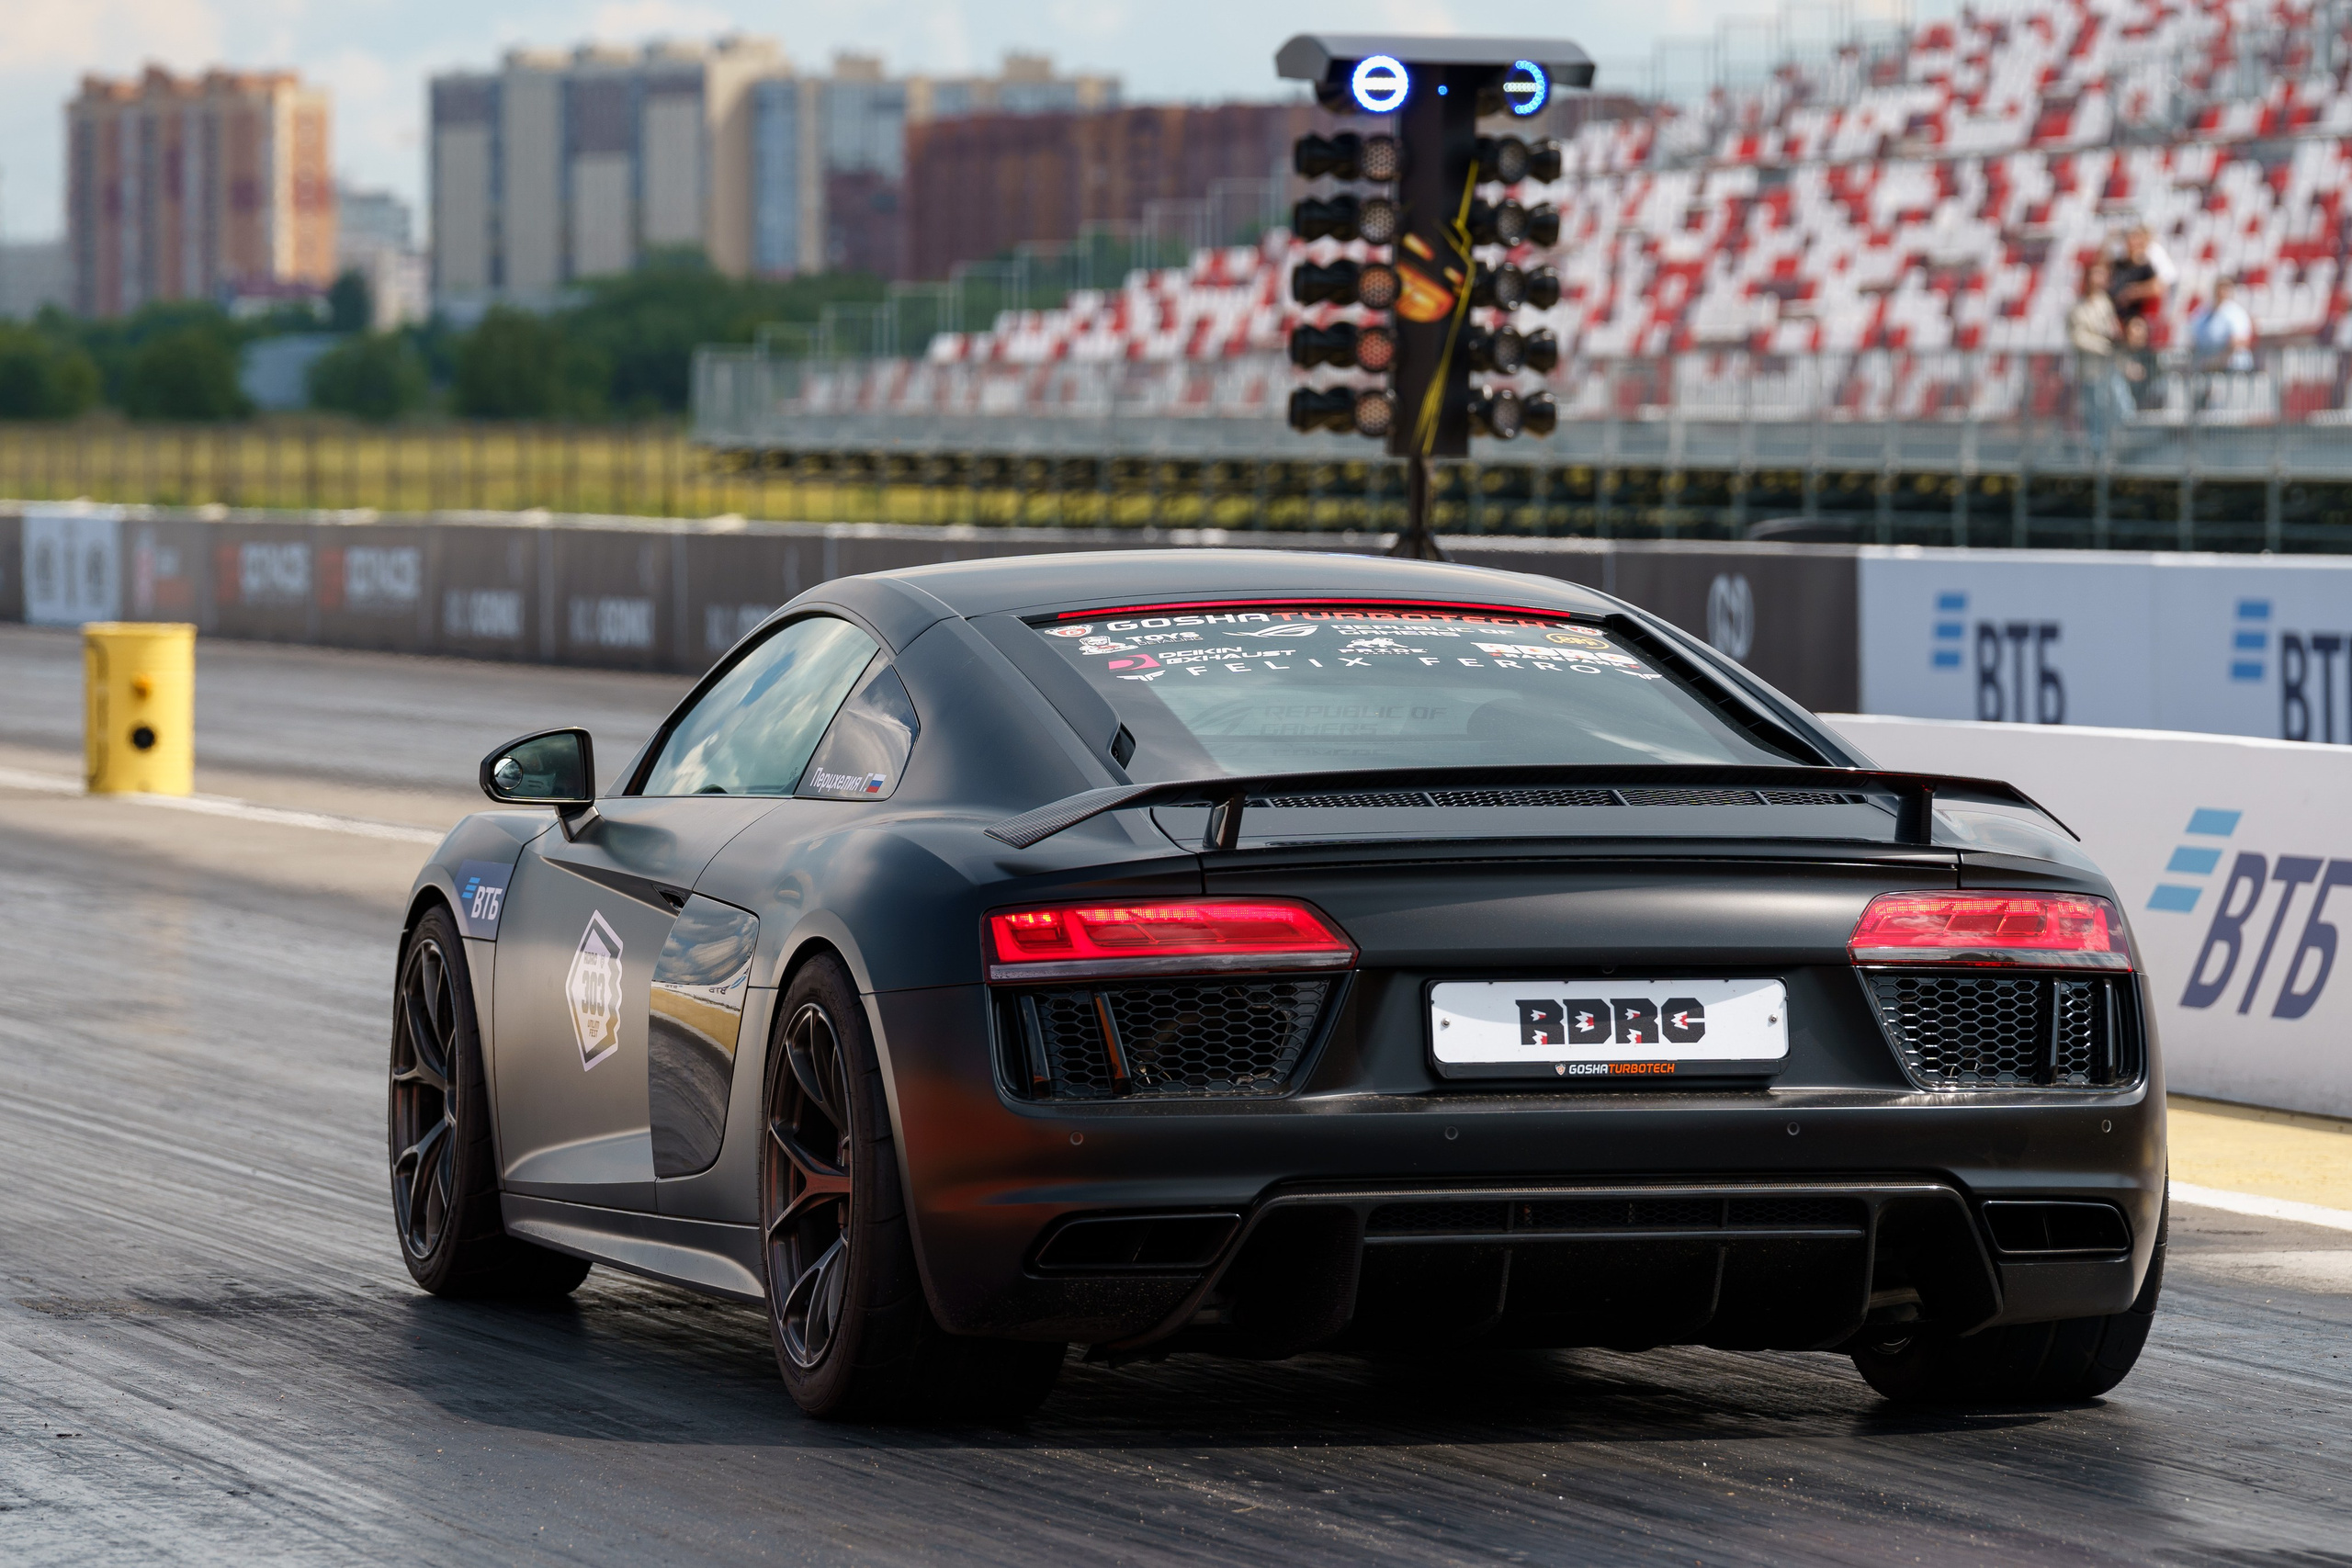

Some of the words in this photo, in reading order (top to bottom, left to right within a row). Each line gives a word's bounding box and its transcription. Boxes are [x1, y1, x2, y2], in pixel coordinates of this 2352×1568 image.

[1106, 611, 1547, 631] GOSHATURBOTECH
[1330, 625, 1475, 634] REPUBLIC
[1338, 629, 1461, 637] GAMERS
[1166, 649, 1296, 665] EXHAUST
[1186, 657, 1373, 677] FELIX
[1418, 657, 1602, 675] FERRO
[1975, 620, 2065, 724] ВТБ
[2280, 631, 2352, 745] ВТ
[470, 885, 503, 920] ВТБ
[2179, 850, 2352, 1021] ВТБ
[582, 970, 605, 1017] 303
[1568, 1064, 1675, 1075] GOSHATURBOTECH
